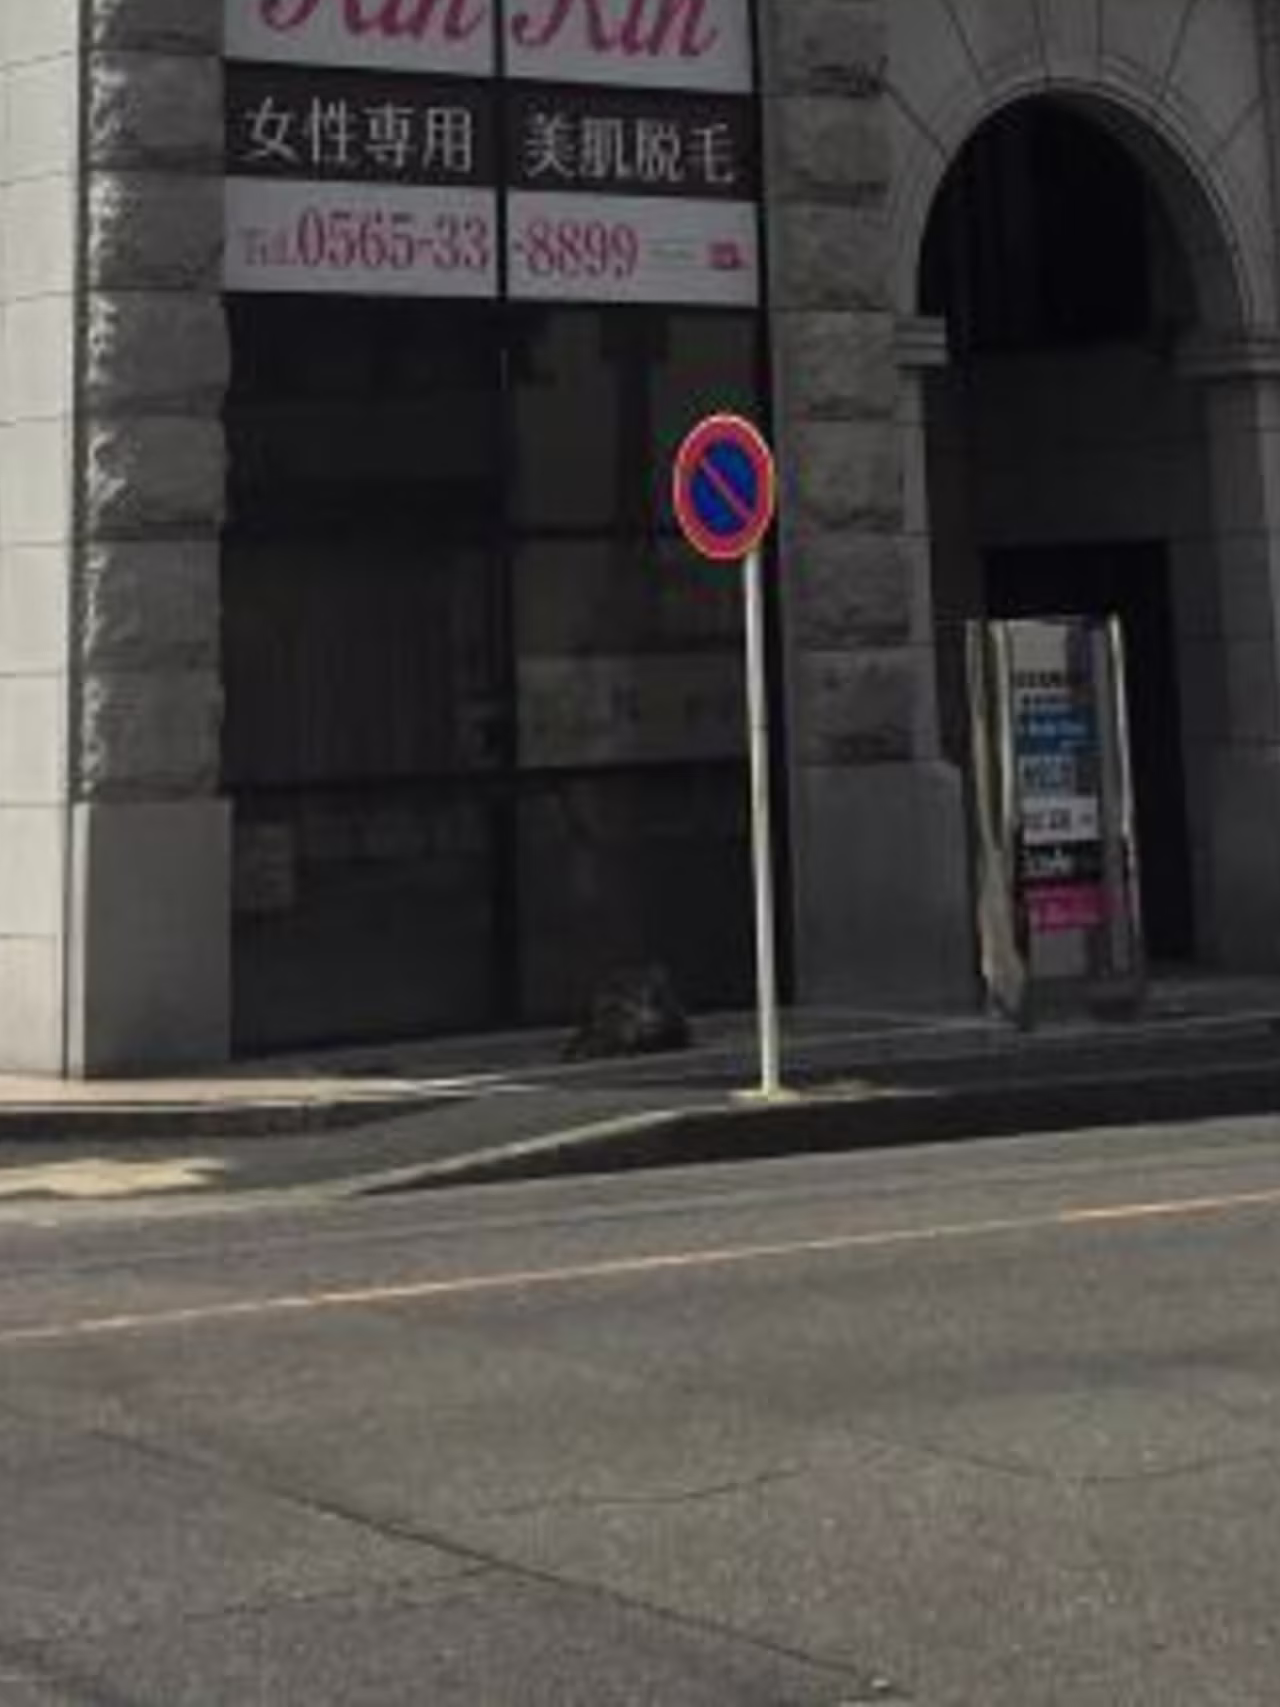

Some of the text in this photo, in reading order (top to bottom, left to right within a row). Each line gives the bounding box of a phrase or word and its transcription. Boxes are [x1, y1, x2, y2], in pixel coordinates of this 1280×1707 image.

[251, 96, 735, 184] 女性専用 美肌脱毛
